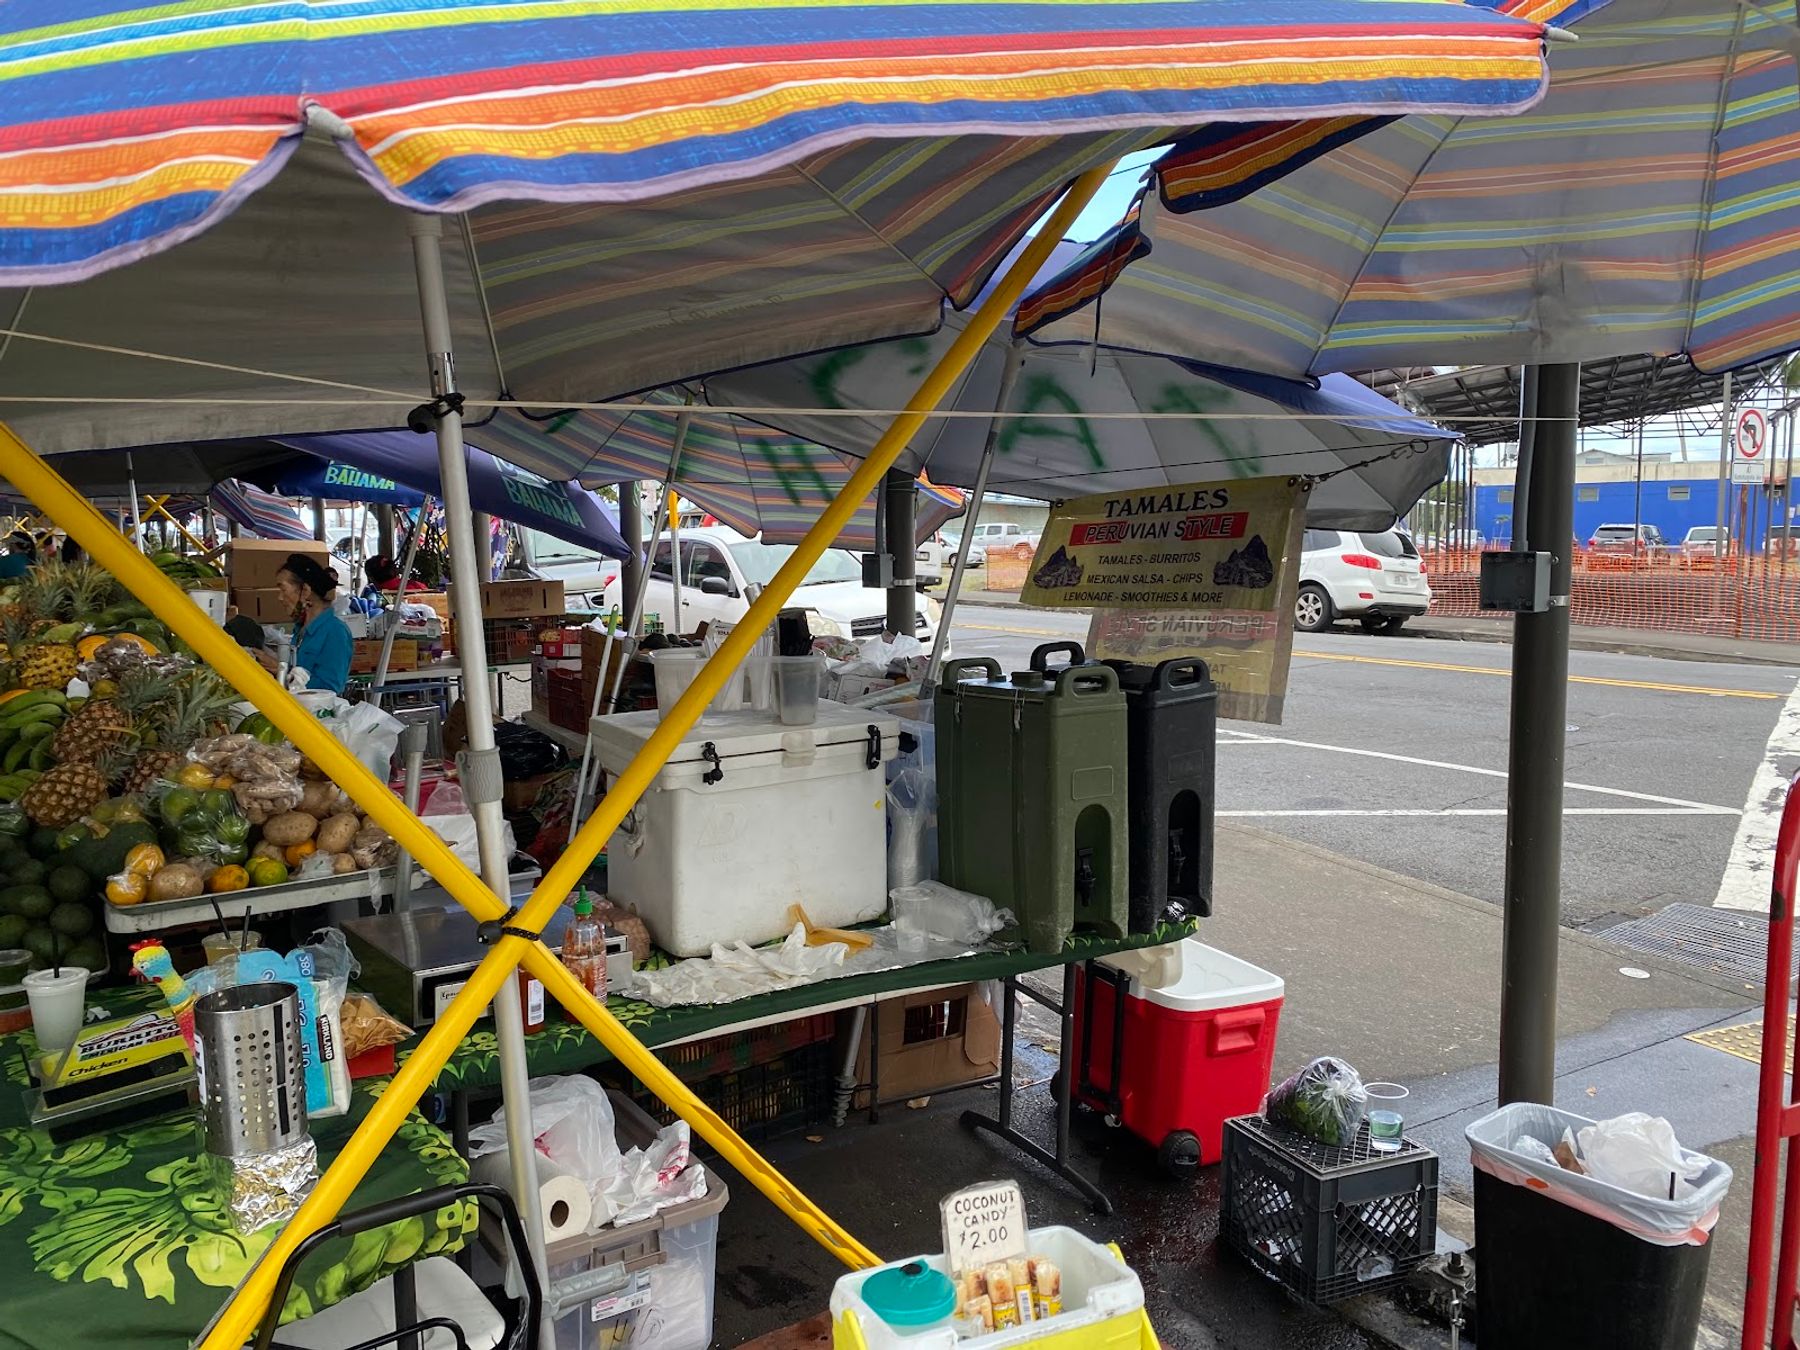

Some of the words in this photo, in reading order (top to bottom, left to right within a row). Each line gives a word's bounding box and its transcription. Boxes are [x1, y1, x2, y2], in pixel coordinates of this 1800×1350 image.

[324, 466, 396, 491] BAHAMA
[501, 475, 587, 529] BAHAMA
[1104, 487, 1229, 518] TAMALES
[1085, 520, 1169, 543] PERUVIAN
[1173, 516, 1234, 538] STYLE
[1098, 553, 1143, 566] TAMALES
[1149, 552, 1201, 565] BURRITOS
[1086, 573, 1129, 585] MEXICAN
[1131, 573, 1164, 585] SALSA
[1172, 572, 1203, 584] CHIPS
[1063, 591, 1114, 602] LEMONADE
[1120, 591, 1178, 602] SMOOTHIES
[1179, 591, 1188, 602] &
[1191, 592, 1224, 604] MORE
[319, 1015, 334, 1061] KIRKLAND
[68, 1057, 129, 1078] Chicken
[954, 1190, 1016, 1215] COCONUT
[959, 1226, 1008, 1250] $2.00
